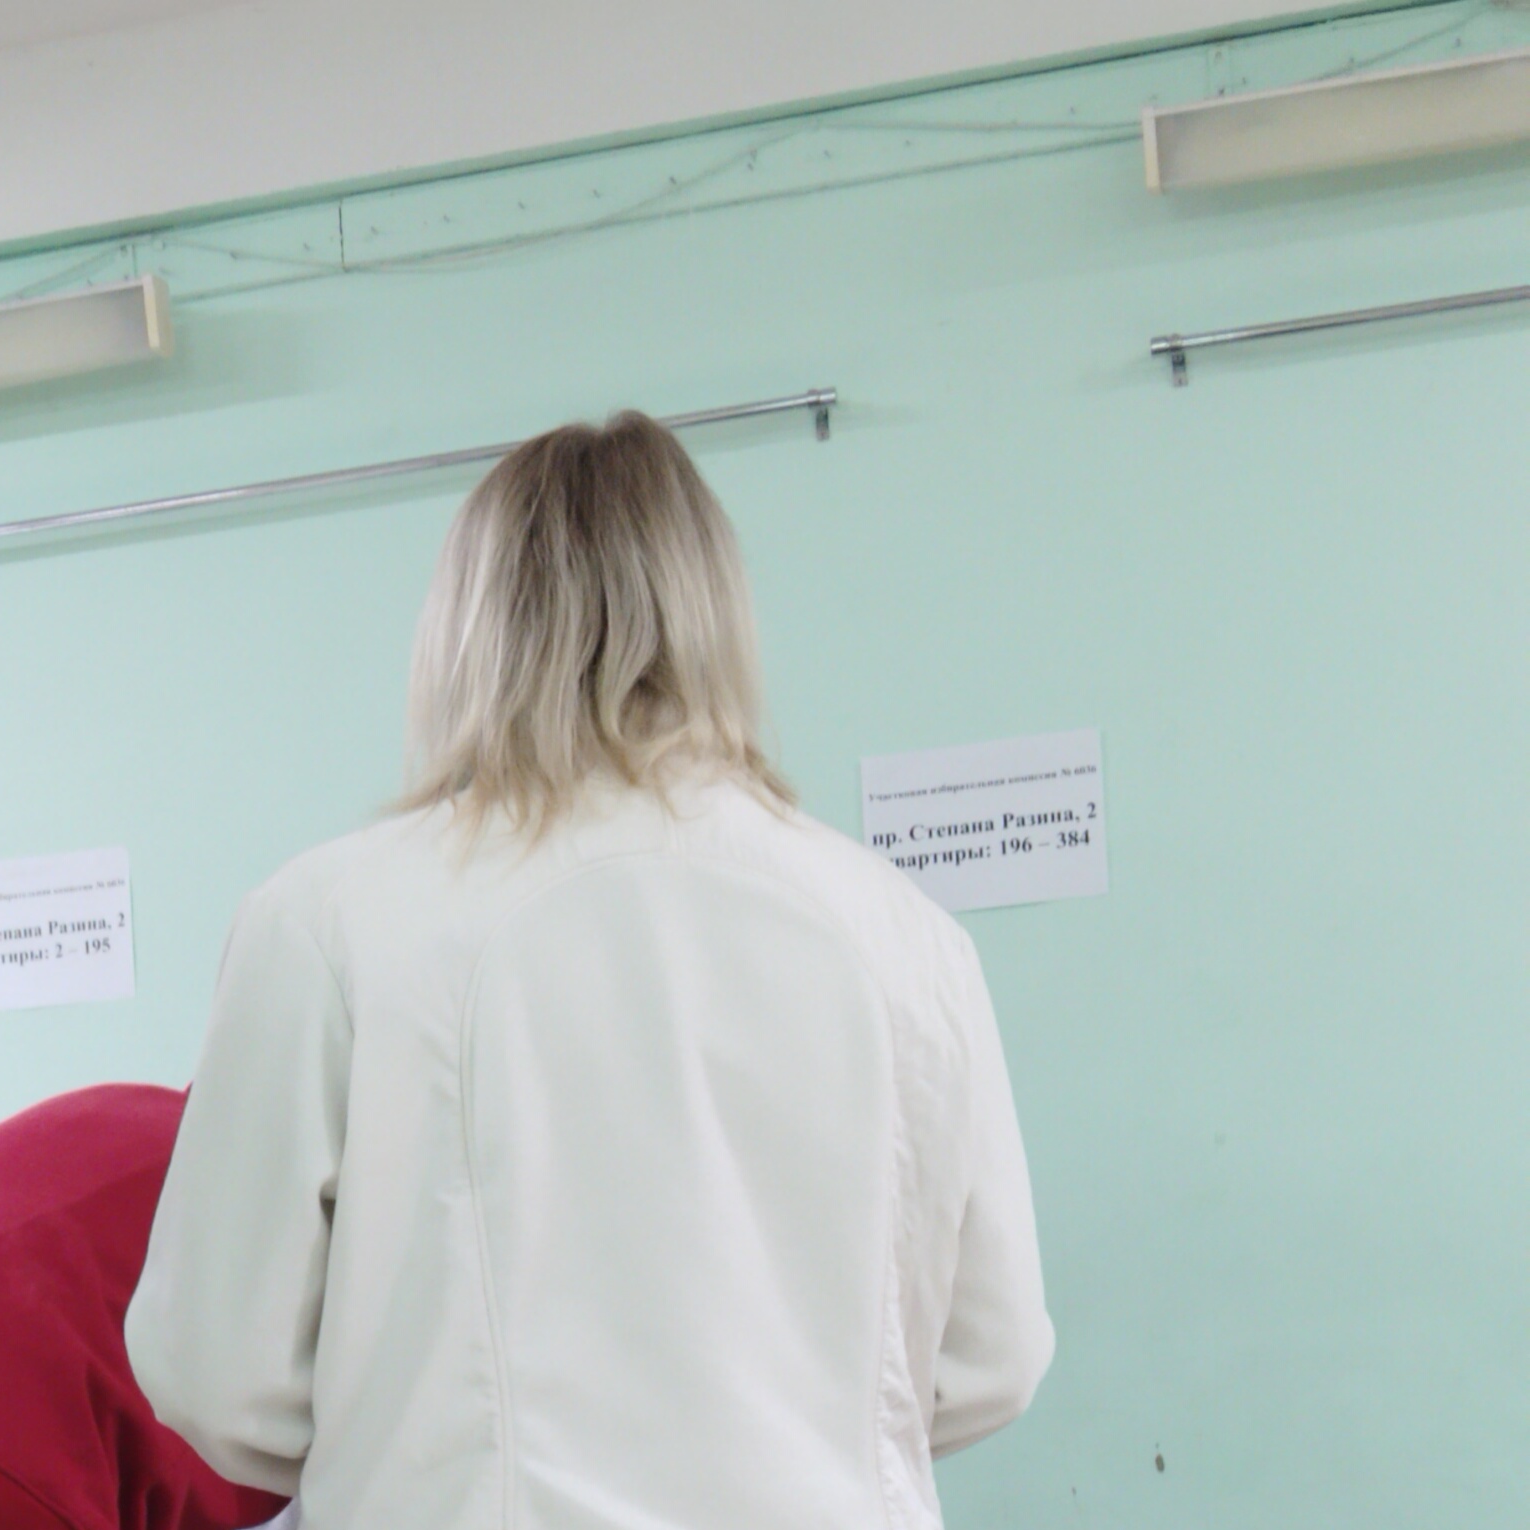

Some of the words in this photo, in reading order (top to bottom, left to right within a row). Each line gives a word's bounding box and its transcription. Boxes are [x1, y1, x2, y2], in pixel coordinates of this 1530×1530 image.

[872, 832, 902, 849] пр.
[909, 819, 995, 841] Степана
[1002, 809, 1081, 829] Разина,
[1087, 801, 1097, 819] 2
[890, 845, 991, 871] вартиры:
[1001, 836, 1033, 856] 196
[1056, 829, 1090, 849] 384
[49, 917, 112, 936] Разина,
[118, 911, 125, 928] 2
[55, 942, 63, 959] 2
[85, 936, 111, 955] 195
